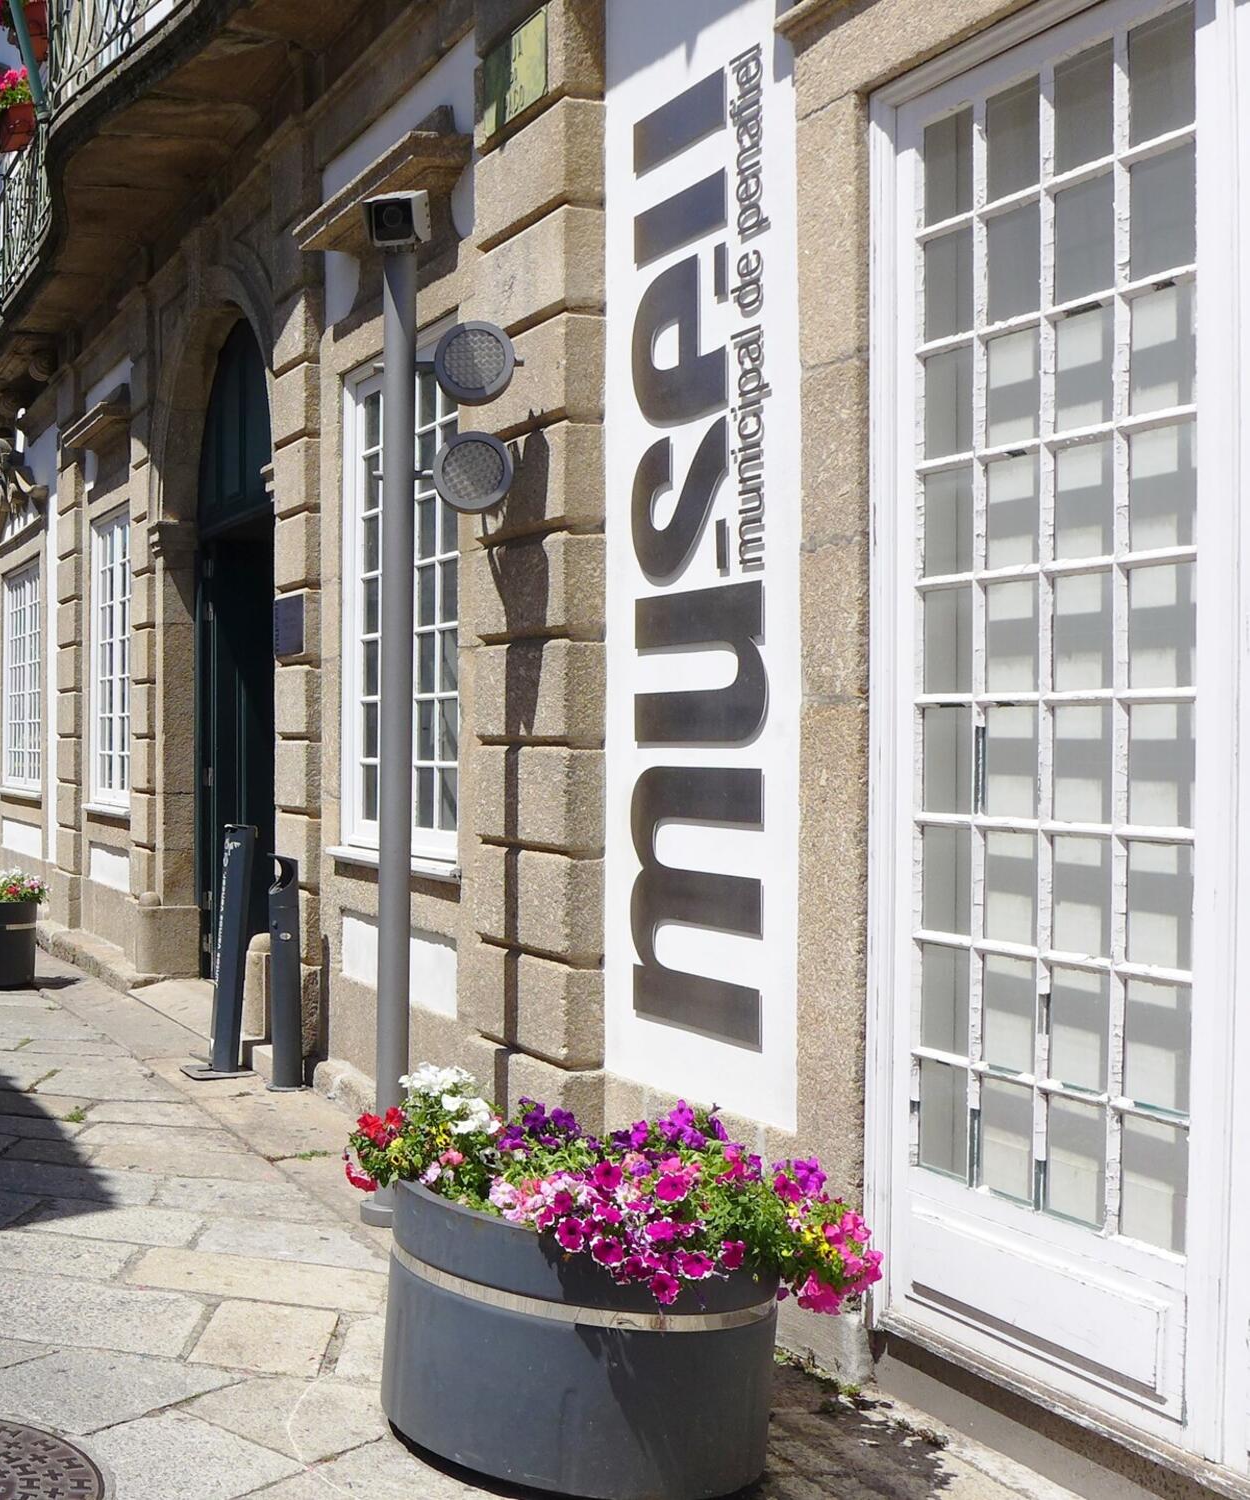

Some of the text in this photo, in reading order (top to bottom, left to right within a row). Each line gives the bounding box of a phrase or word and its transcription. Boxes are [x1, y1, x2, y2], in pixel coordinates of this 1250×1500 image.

[730, 44, 768, 566] municipal de penafiel
